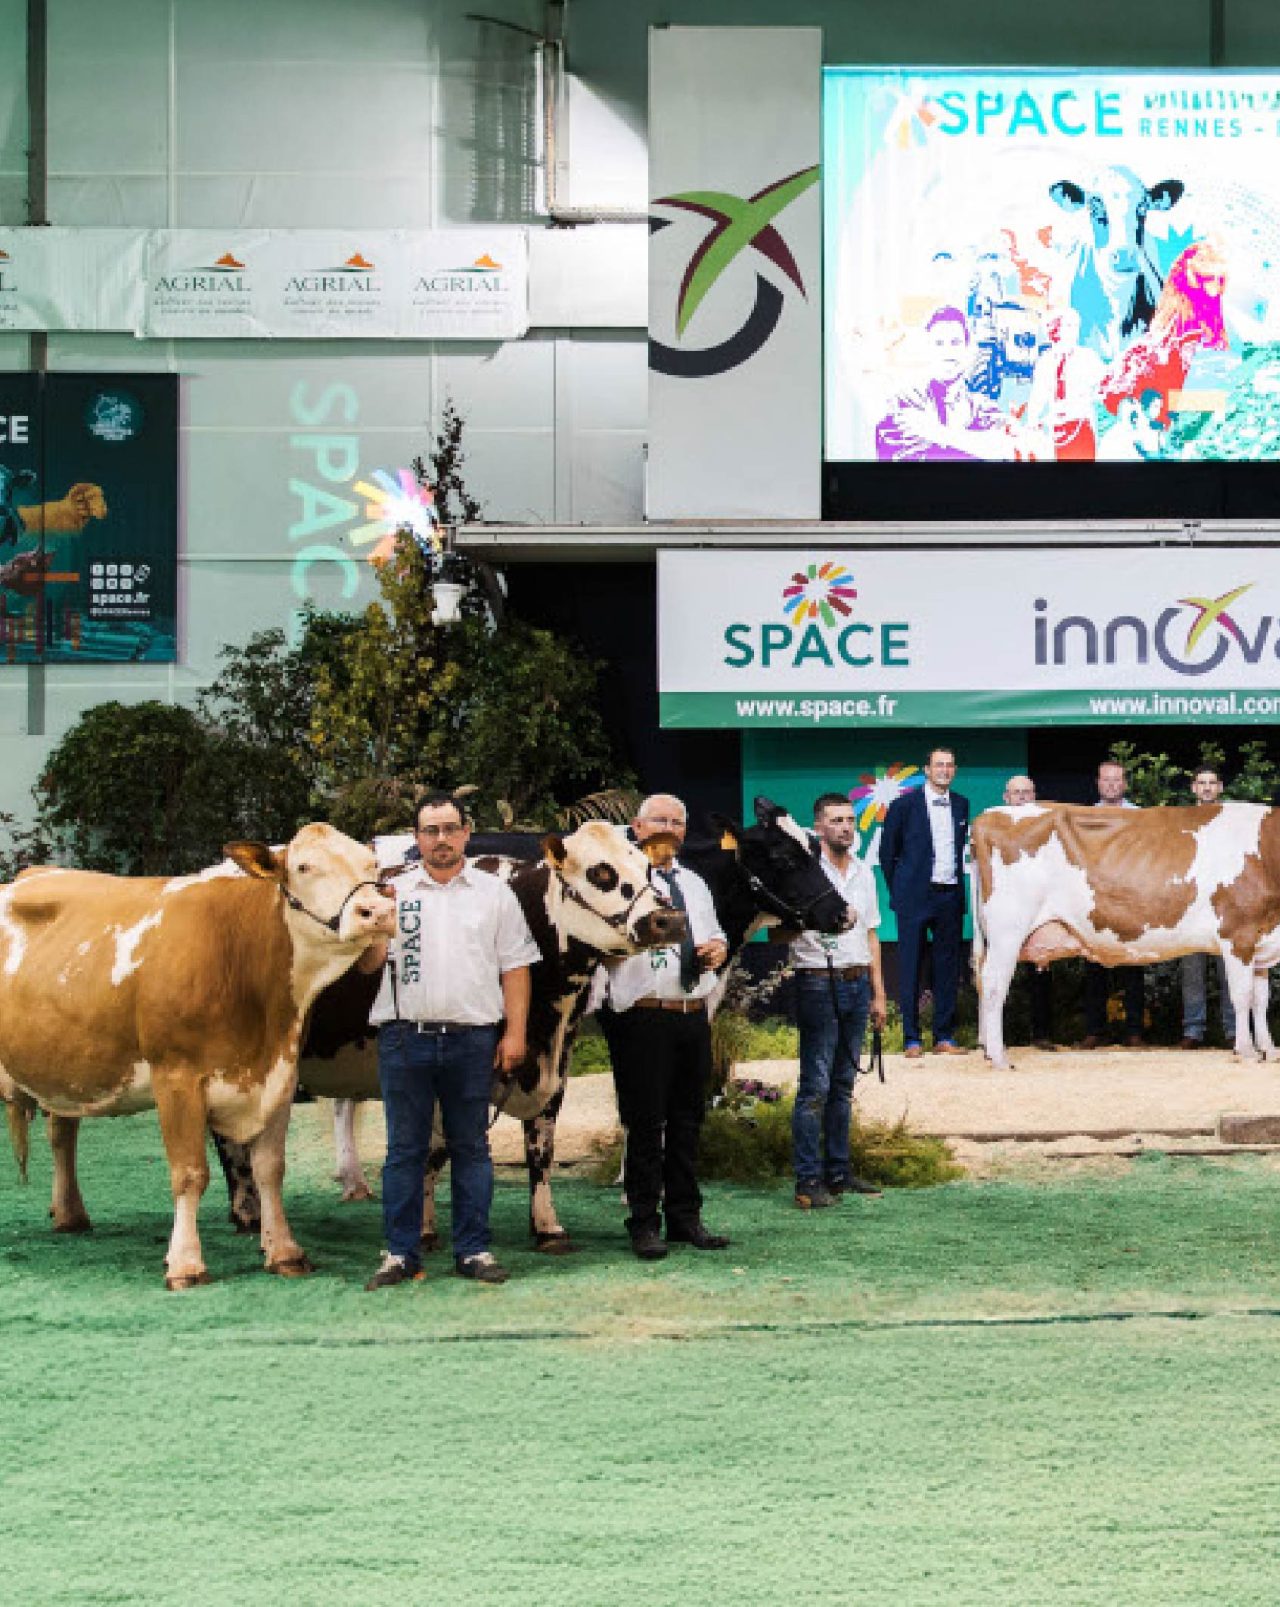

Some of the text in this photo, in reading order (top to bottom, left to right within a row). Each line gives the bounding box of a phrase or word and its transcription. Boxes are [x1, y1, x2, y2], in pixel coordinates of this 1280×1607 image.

[937, 89, 1123, 137] SPACE
[1138, 118, 1243, 138] RENNES
[154, 276, 251, 292] AGRIAL
[284, 276, 381, 292] AGRIAL
[412, 276, 509, 292] AGRIAL
[288, 379, 360, 647] SPAC
[722, 622, 911, 668] SPACE
[736, 695, 897, 721] www.space.fr
[399, 900, 422, 986] SPACE
